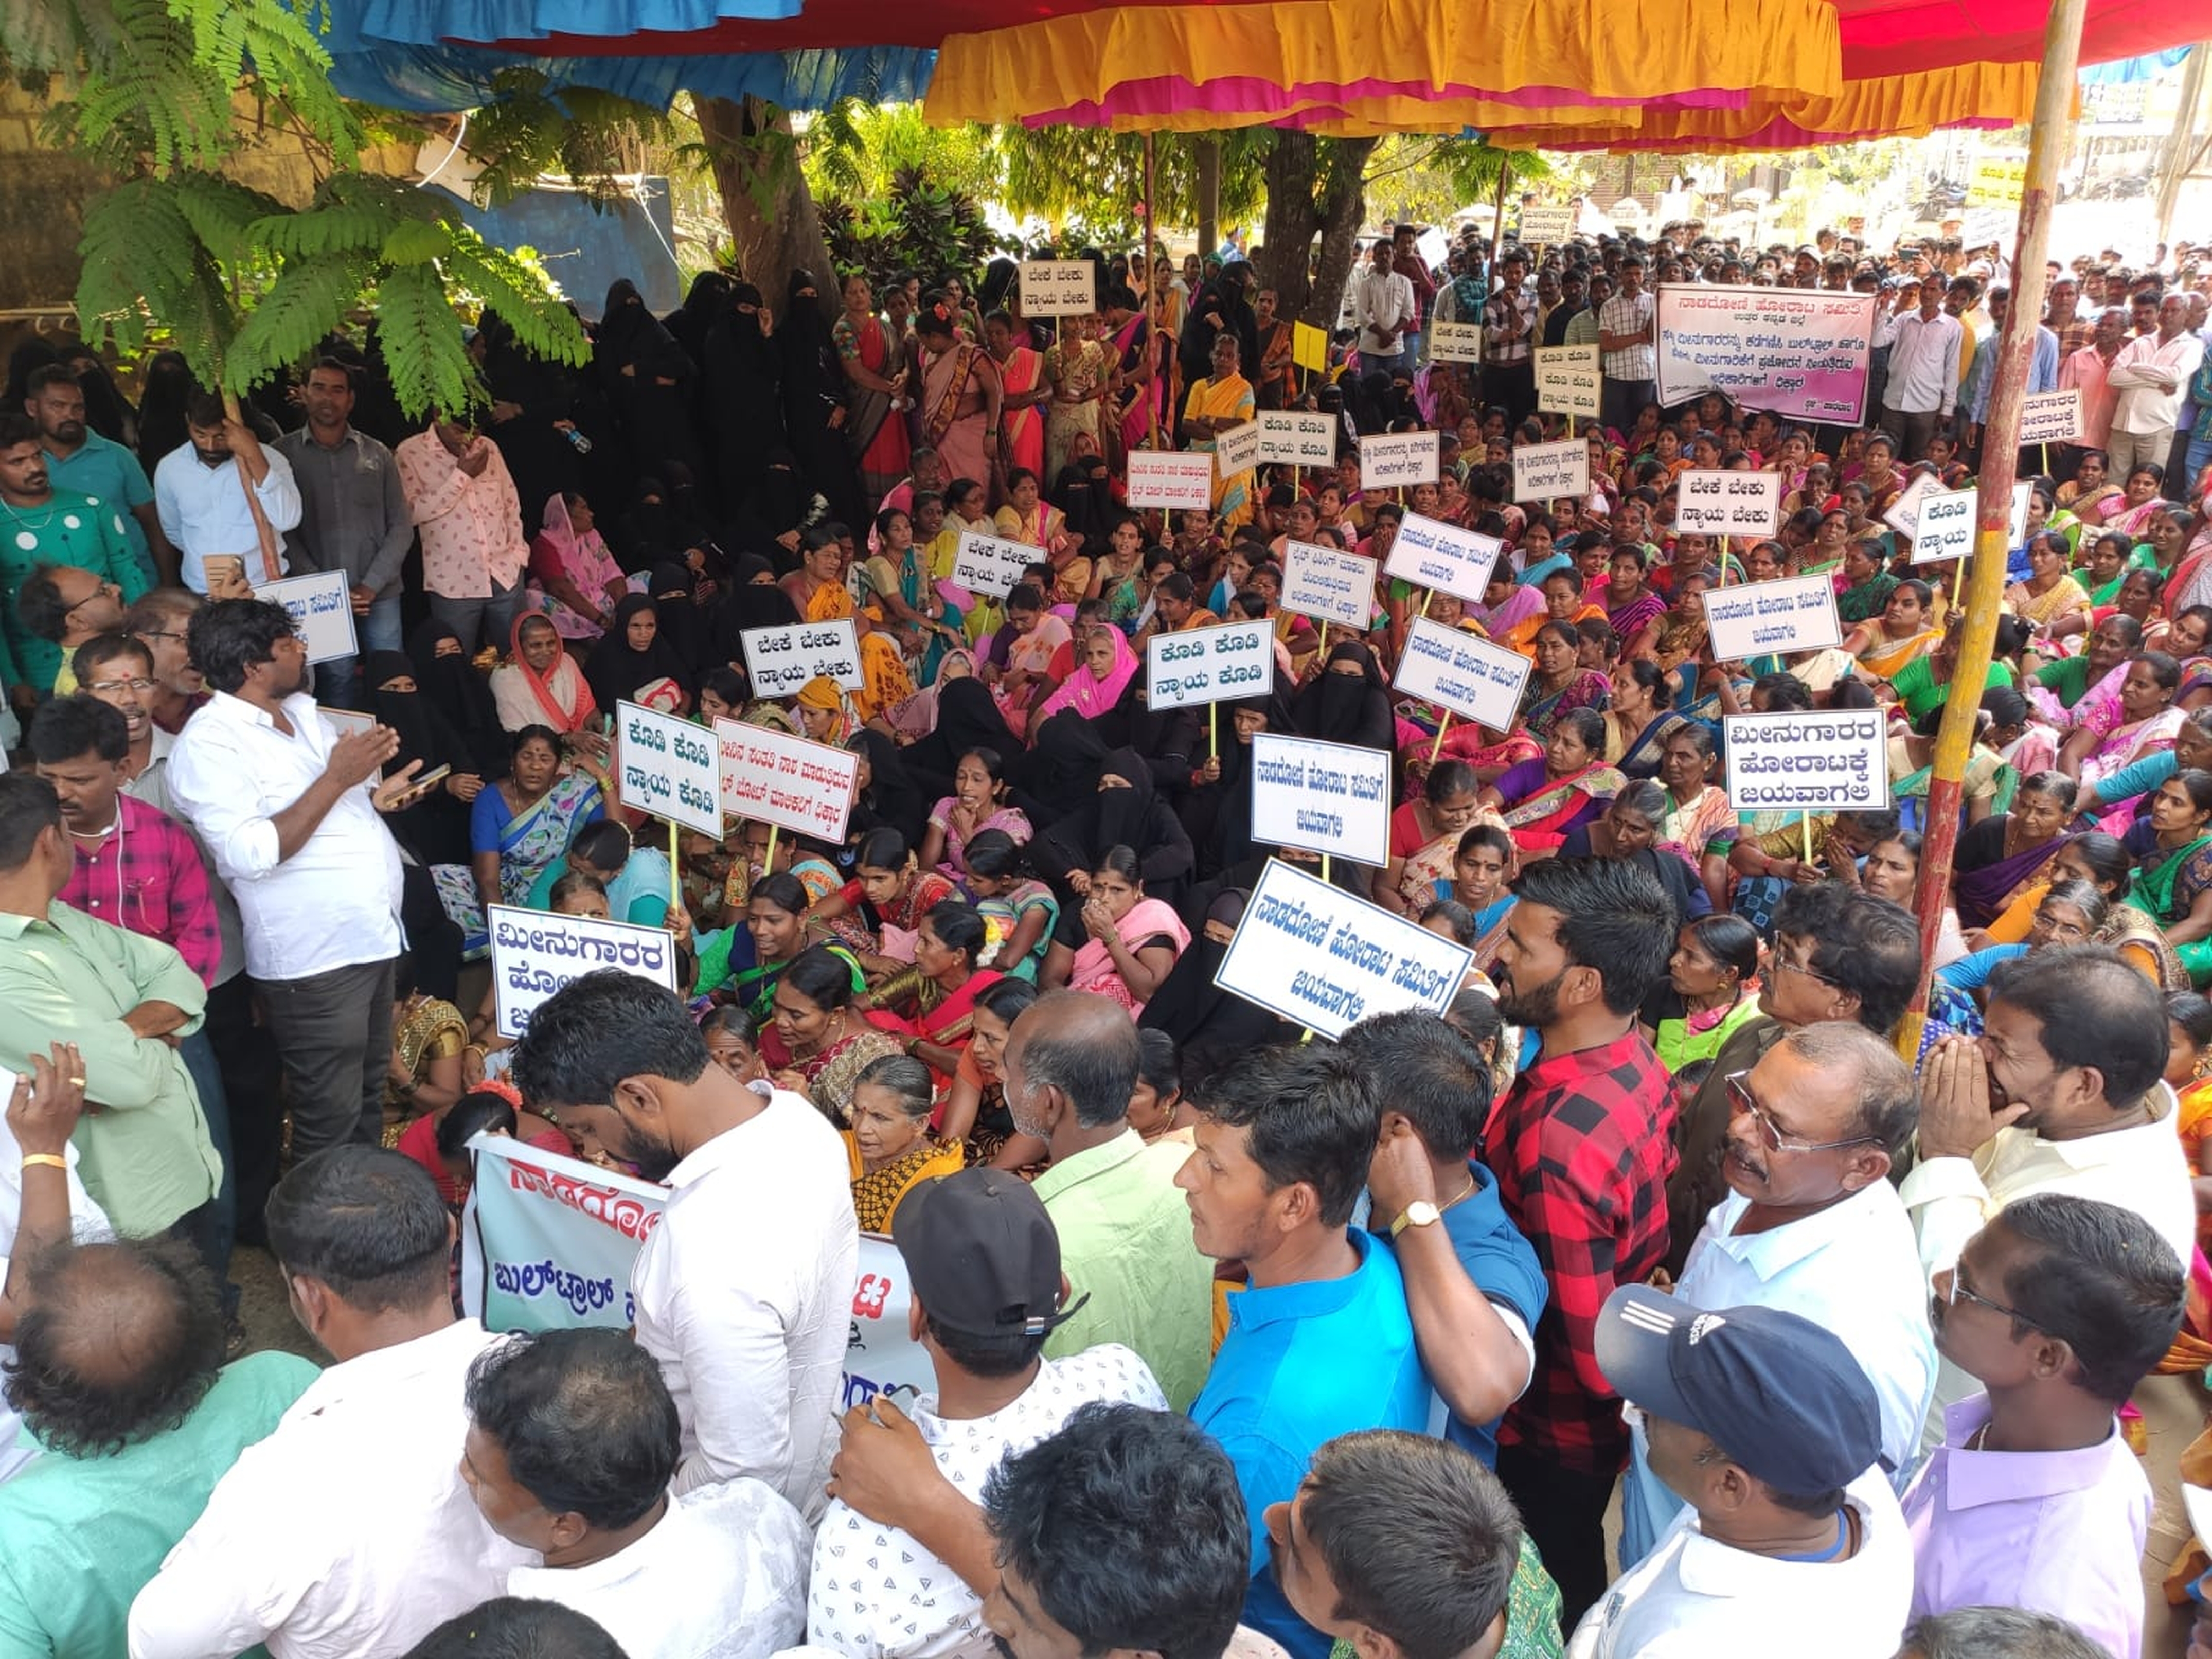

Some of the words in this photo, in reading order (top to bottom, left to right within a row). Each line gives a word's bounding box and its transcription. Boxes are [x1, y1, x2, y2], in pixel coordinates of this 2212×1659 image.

[1057, 267, 1083, 281] ಬೇಕು
[1025, 292, 1057, 311] ನ್ಯಾಯ
[1063, 290, 1088, 304] ಬೇಕು
[1756, 299, 1815, 313] ಹೋರಾಟ
[2024, 393, 2076, 410] ನುಗಾರರ
[1265, 417, 1293, 431] ಕೊಡಿ
[1299, 419, 1326, 433] ಕೊಡಿ
[2020, 426, 2075, 441] ಯವಾಗಲಿ
[1261, 439, 1294, 459] ನ್ಯಾಯ
[1300, 441, 1327, 456] ಕೊಡಿ
[1729, 478, 1764, 495] ಬೇಕು
[1682, 506, 1725, 528] ನ್ಯಾಯ
[1733, 506, 1769, 522] ಬೇಕು
[1929, 501, 1967, 520] ಕೊಡಿ
[1920, 528, 1967, 554] ನ್ಯಾಯ
[958, 565, 995, 585] ನ್ಯಾಯ
[310, 587, 343, 614] ಸಮಿತಿಗೆ
[1757, 596, 1794, 615] ಹೋರಾಟ
[800, 631, 841, 649] ಬೇಕು
[1753, 623, 1796, 643] ಜಯವಾಗಲಿ
[1161, 641, 1205, 662] ಕೊಡಿ
[1215, 633, 1259, 653] ಕೊಡಿ
[758, 664, 805, 691] ನ್ಯಾಯ
[814, 659, 853, 676] ಬೇಕು
[1156, 669, 1208, 700] ನ್ಯಾಯ
[1219, 665, 1262, 684] ಕೊಡಿ
[629, 718, 666, 752] ಕೊಡಿ
[674, 732, 709, 768] ಕೊಡಿ
[1731, 719, 1876, 744] ಮೀನುಗಾರರ
[1739, 748, 1869, 781] ಹೋರಾಟಕ್ಕೆ
[627, 766, 670, 804] ನ್ಯಾಯ
[679, 778, 713, 814] ಕೊಡಿ
[1308, 761, 1347, 795] ಹೋರಾಟ
[1351, 772, 1383, 802] ಸಮಿತಿಗೆ
[1740, 780, 1870, 802] ಜಯವಾಗಲಿ
[1296, 806, 1343, 838] ಜಯವಾಗಲಿ
[496, 922, 663, 970] ಮೀನುಗಾರರ
[1329, 922, 1393, 976] ಹೋರಾಟ
[1392, 957, 1453, 1003] ಸಮಿತಿಗೆ
[1290, 969, 1365, 1022] ಜಯವಾಗಲಿ
[507, 1157, 663, 1243] ನಾಡದೋ
